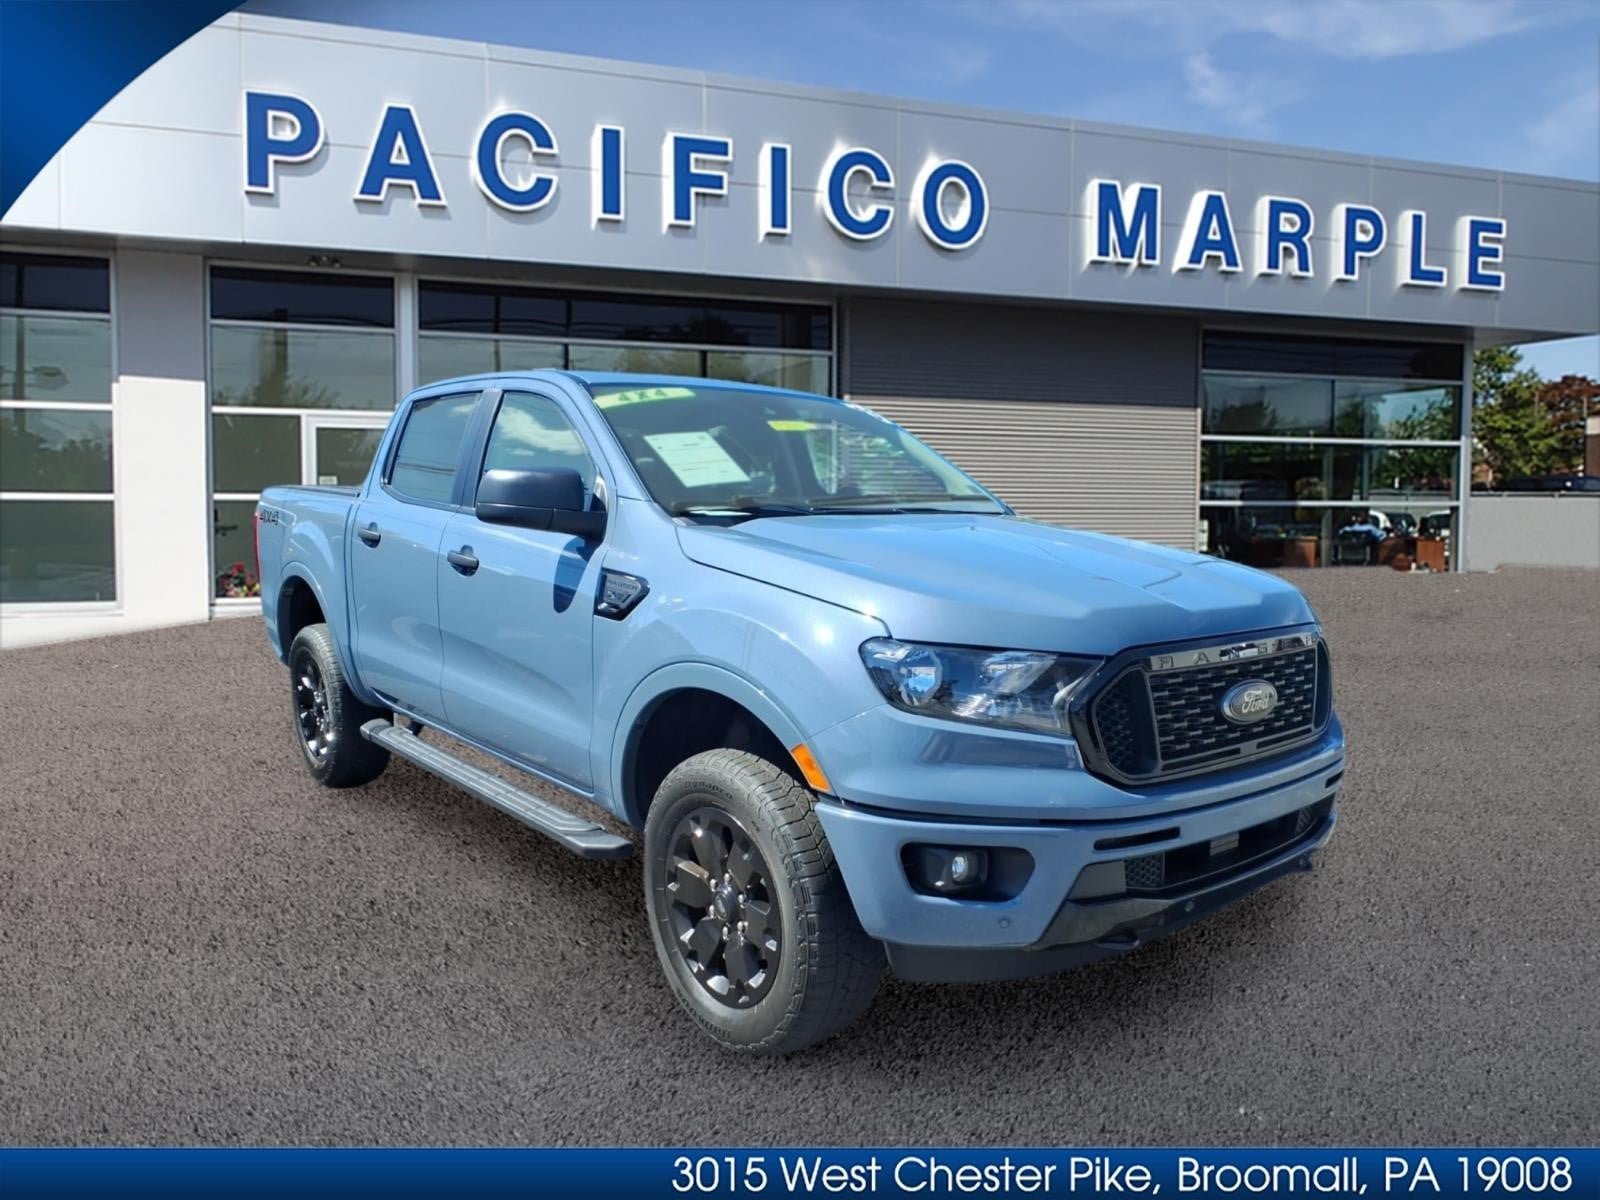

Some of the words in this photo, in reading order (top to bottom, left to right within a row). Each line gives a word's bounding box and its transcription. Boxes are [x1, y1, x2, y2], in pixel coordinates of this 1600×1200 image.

[242, 90, 989, 250] PACIFICO
[1085, 178, 1507, 291] MARPLE
[1242, 690, 1272, 714] Ford
